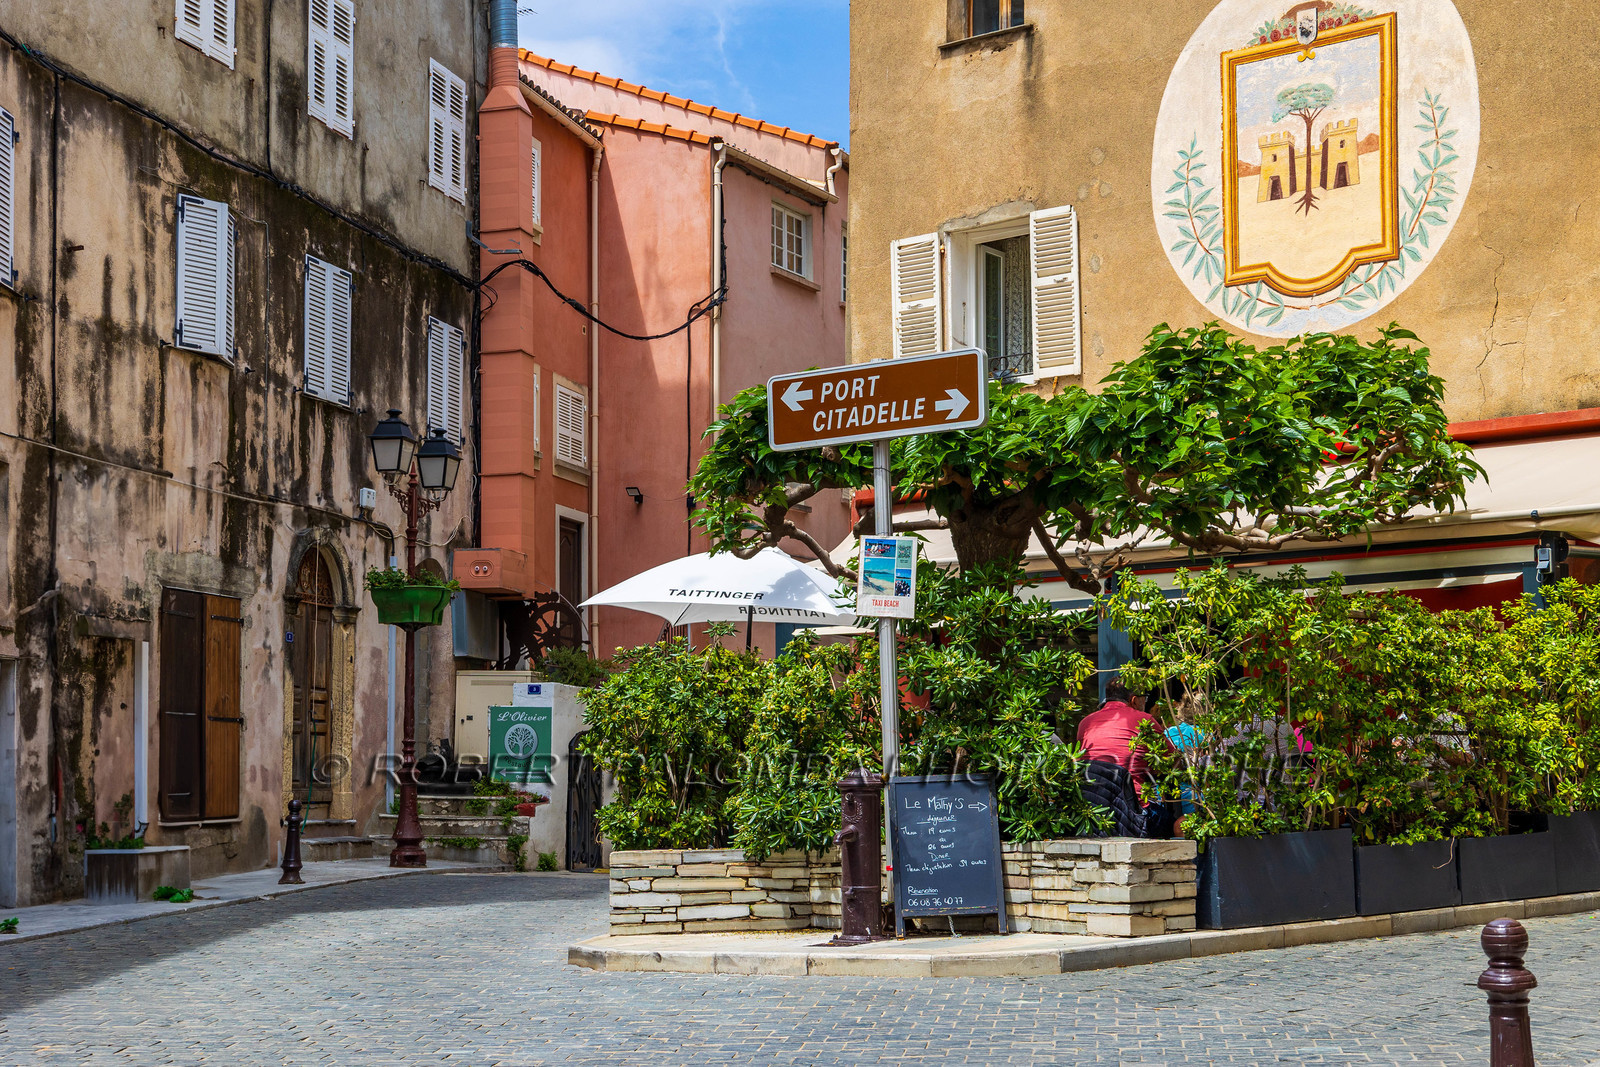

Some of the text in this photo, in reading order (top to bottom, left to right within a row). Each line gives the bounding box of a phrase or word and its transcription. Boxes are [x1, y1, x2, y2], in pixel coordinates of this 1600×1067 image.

[820, 375, 880, 403] PORT
[812, 397, 926, 432] CITADELLE
[669, 588, 764, 600] TAITTINGER
[872, 599, 900, 608] TAXI BEACH
[497, 711, 547, 722] L'Olivier
[904, 797, 922, 809] Le
[907, 898, 919, 907] 06
[919, 898, 931, 907] 08
